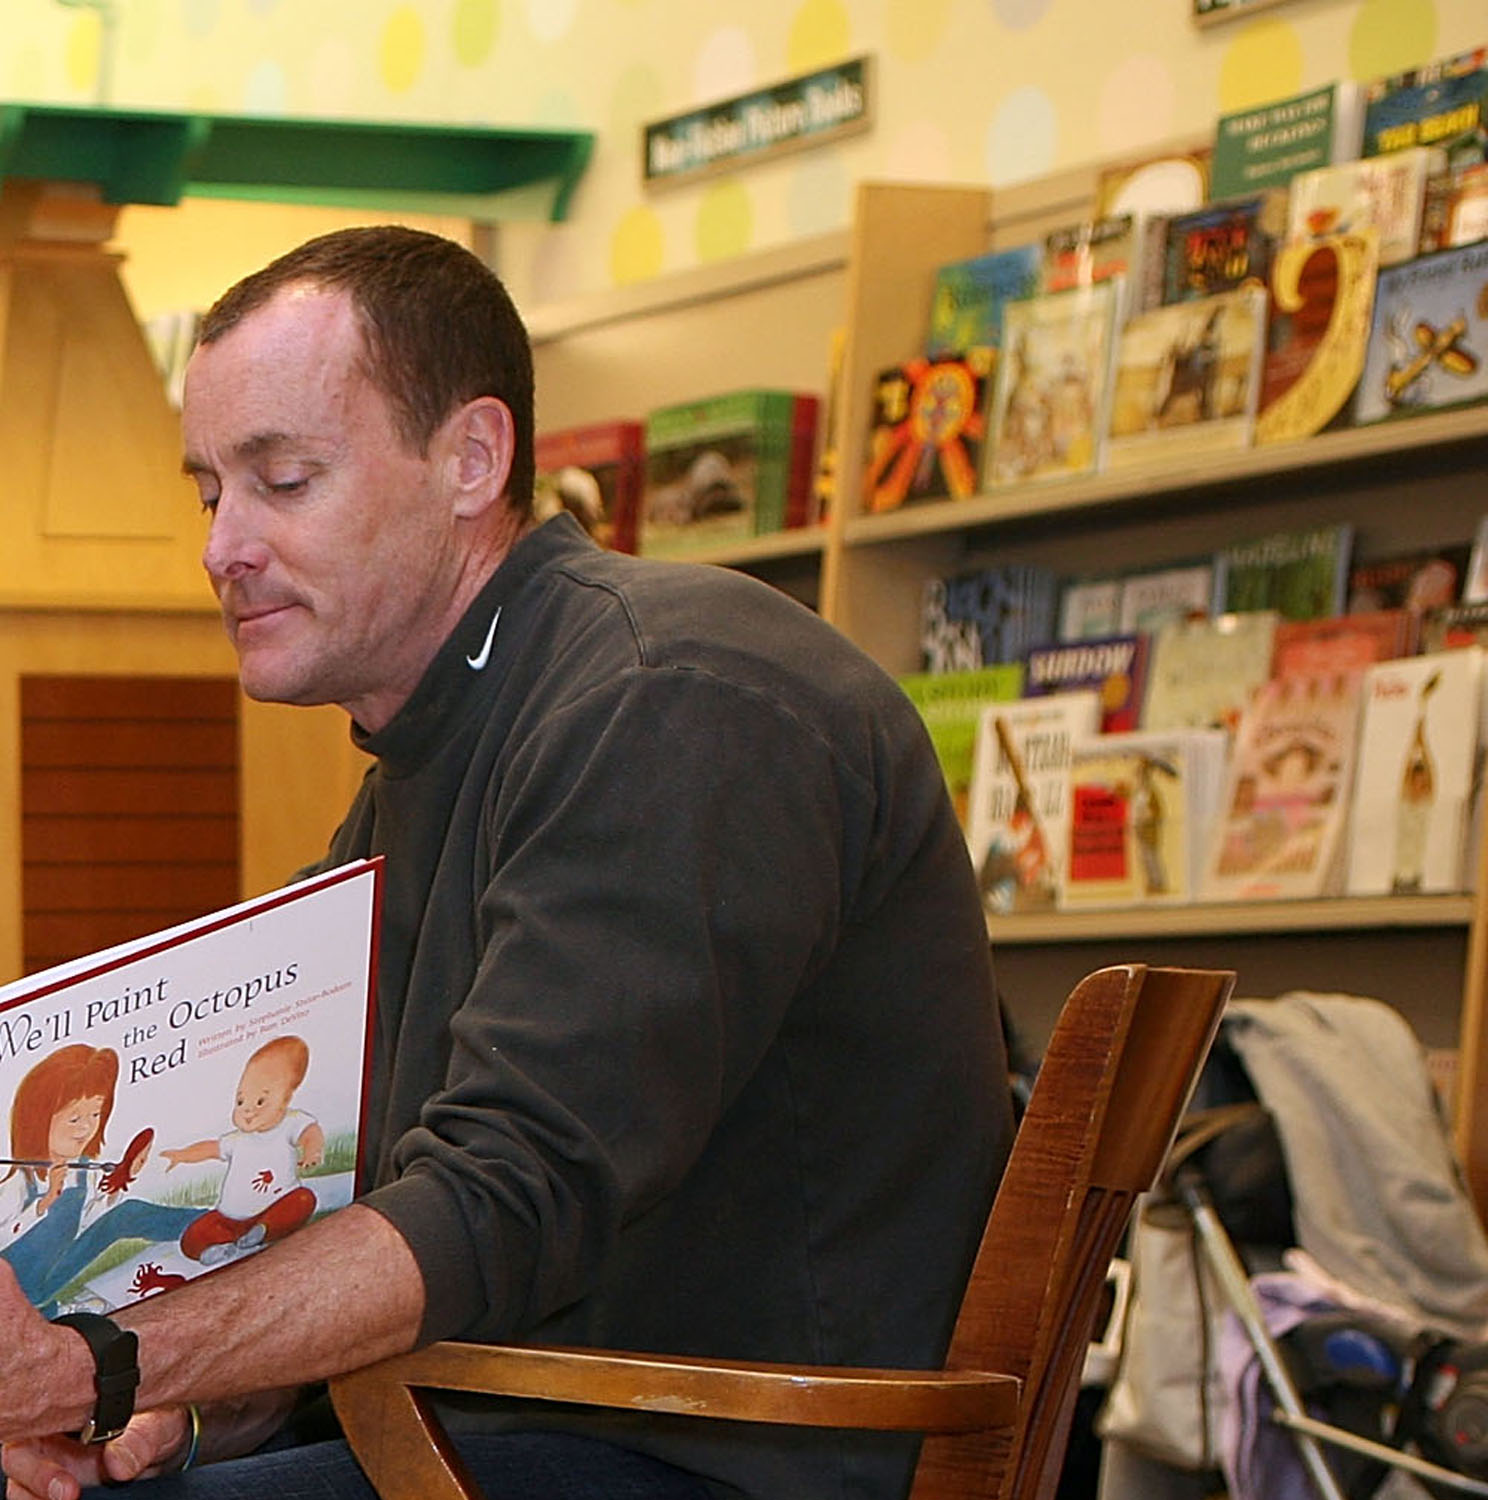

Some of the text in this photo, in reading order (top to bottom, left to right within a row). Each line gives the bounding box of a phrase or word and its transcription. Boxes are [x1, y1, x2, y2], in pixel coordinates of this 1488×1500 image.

[84, 976, 169, 1031] Paint
[123, 961, 298, 1049] the Octopus
[128, 1041, 187, 1086] Red
